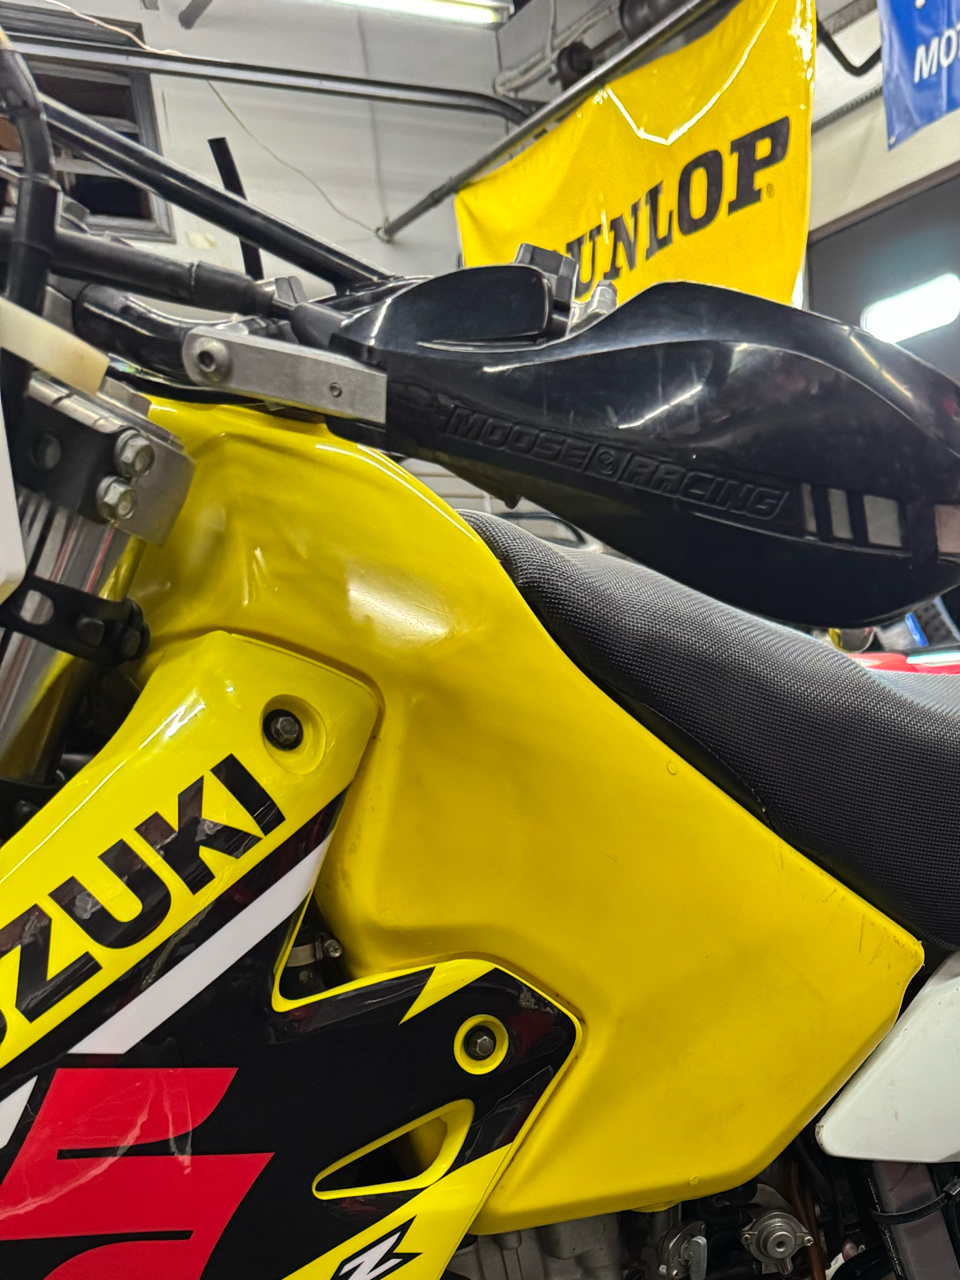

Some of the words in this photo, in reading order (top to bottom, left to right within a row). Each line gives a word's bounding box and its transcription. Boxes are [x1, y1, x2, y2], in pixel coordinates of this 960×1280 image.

[565, 116, 790, 298] UNLOP
[450, 406, 596, 471] MOOSE
[618, 450, 789, 520] RACING
[0, 753, 286, 1046] ZUKI
